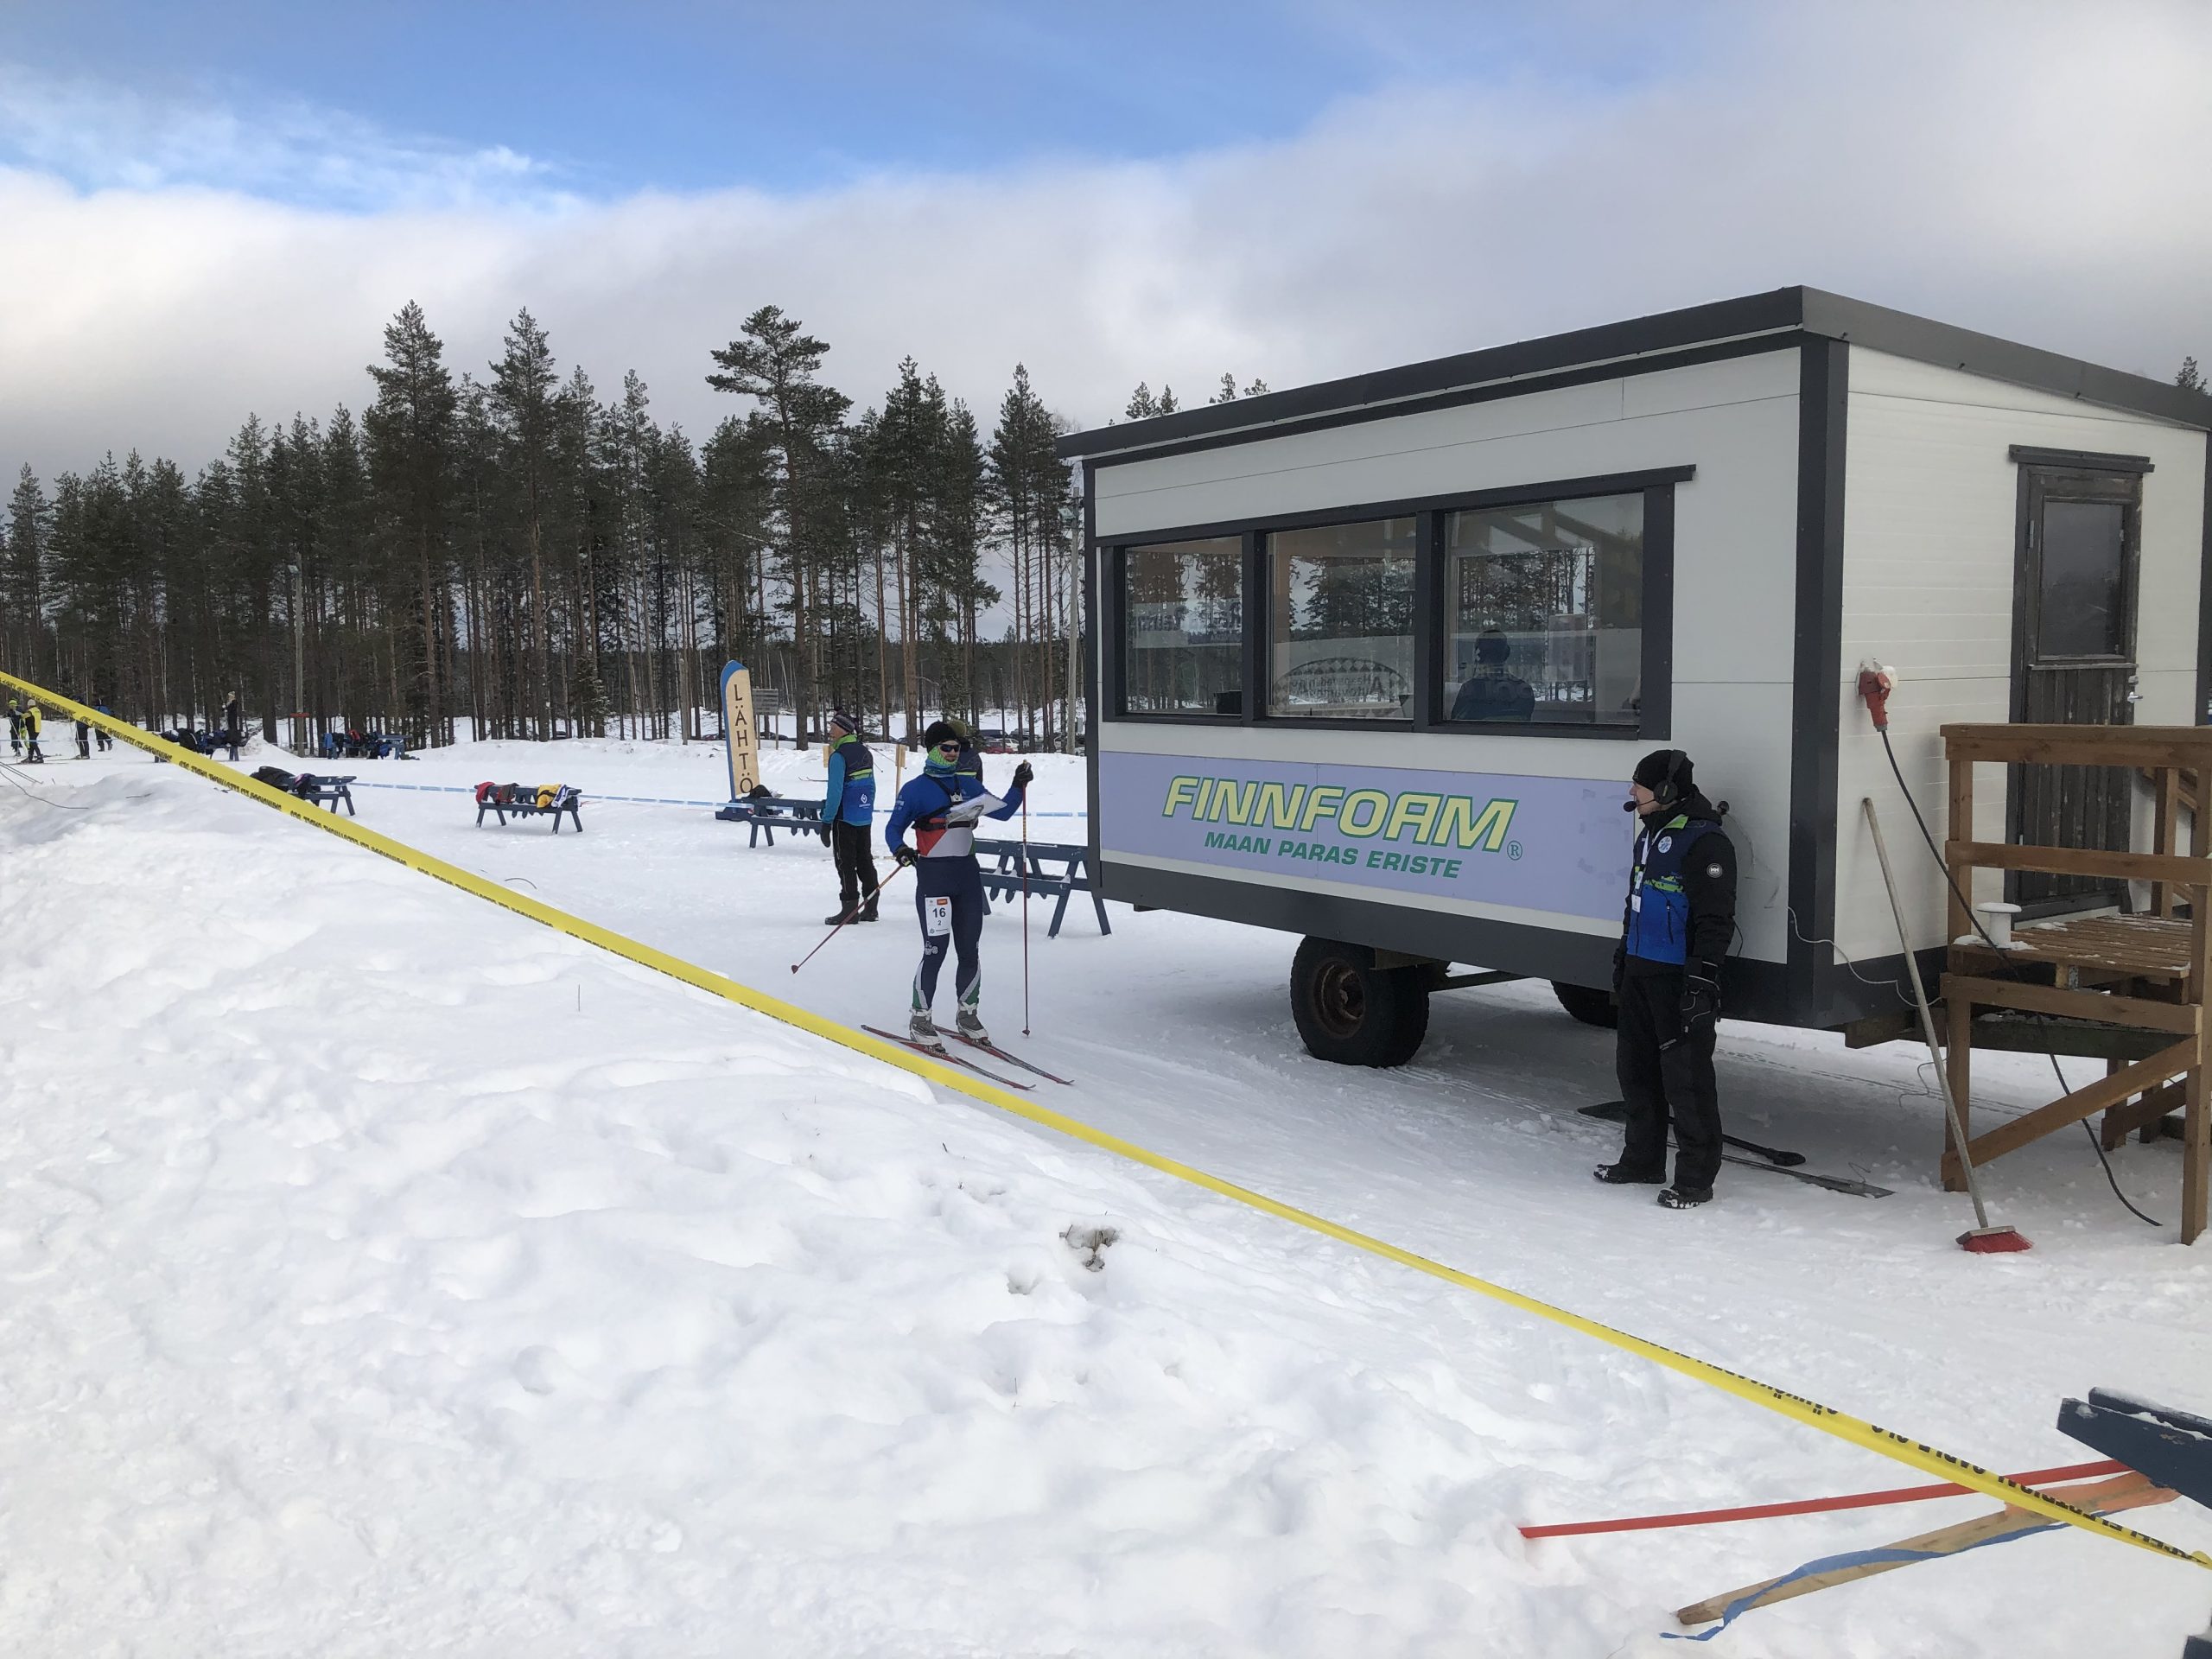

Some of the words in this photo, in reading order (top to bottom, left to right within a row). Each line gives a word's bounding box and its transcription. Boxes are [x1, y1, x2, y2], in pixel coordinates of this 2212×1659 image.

[734, 684, 753, 793] LÄHTÖ
[1162, 775, 1518, 853] FINNFOAM
[1205, 832, 1271, 855] MAAN
[1278, 840, 1358, 866] PARAS
[1366, 850, 1462, 878] ERISTE
[932, 907, 946, 918] 16
